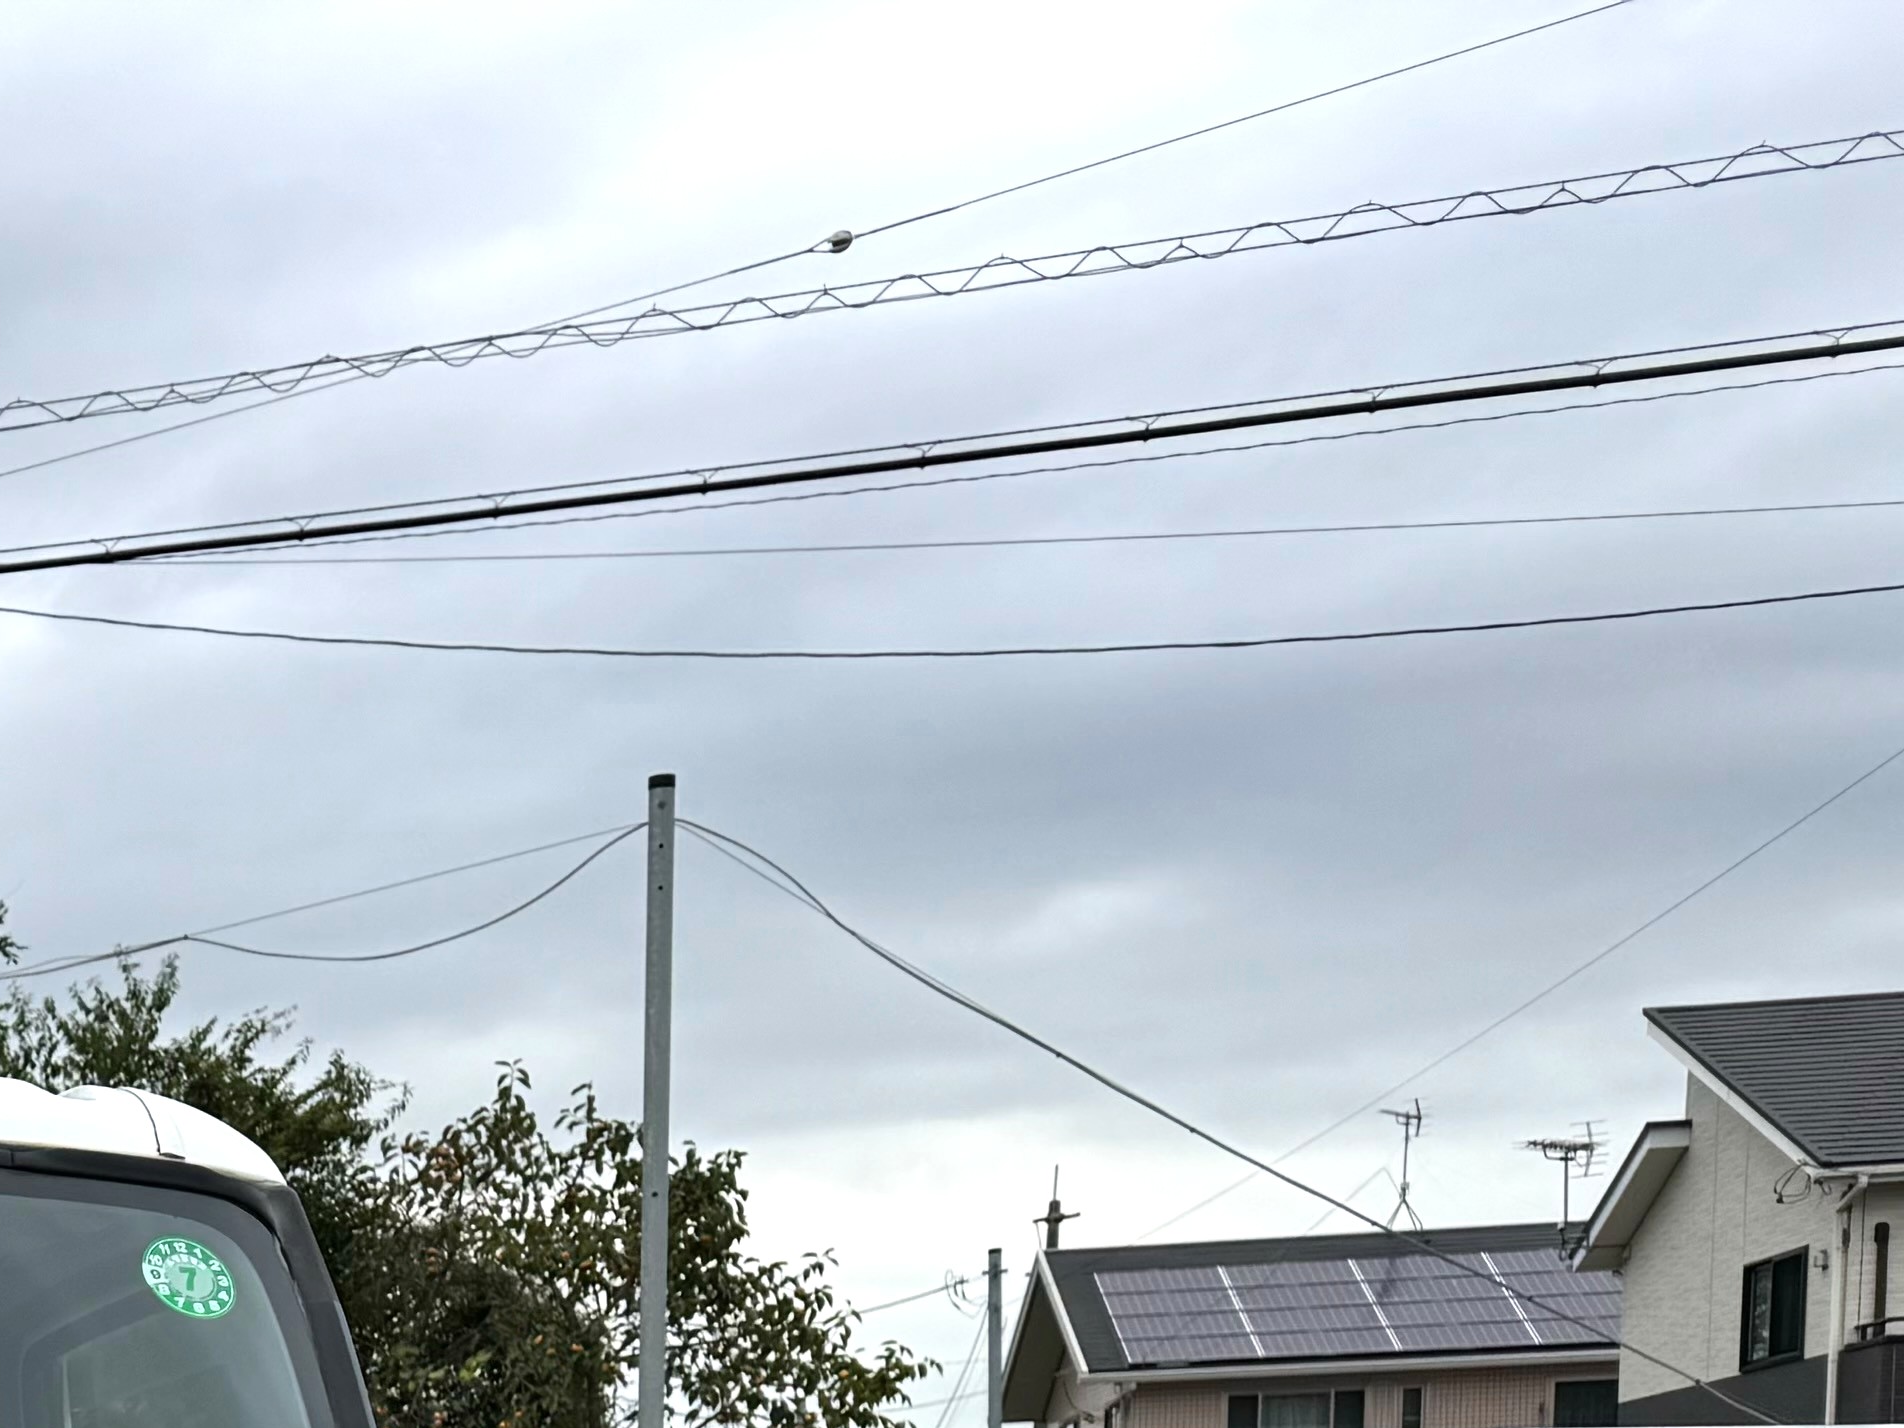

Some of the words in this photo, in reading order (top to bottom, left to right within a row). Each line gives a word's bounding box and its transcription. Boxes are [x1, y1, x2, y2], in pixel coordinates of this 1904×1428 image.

[193, 1248, 203, 1259] 1
[208, 1260, 221, 1272] 2
[178, 1266, 197, 1292] 7
